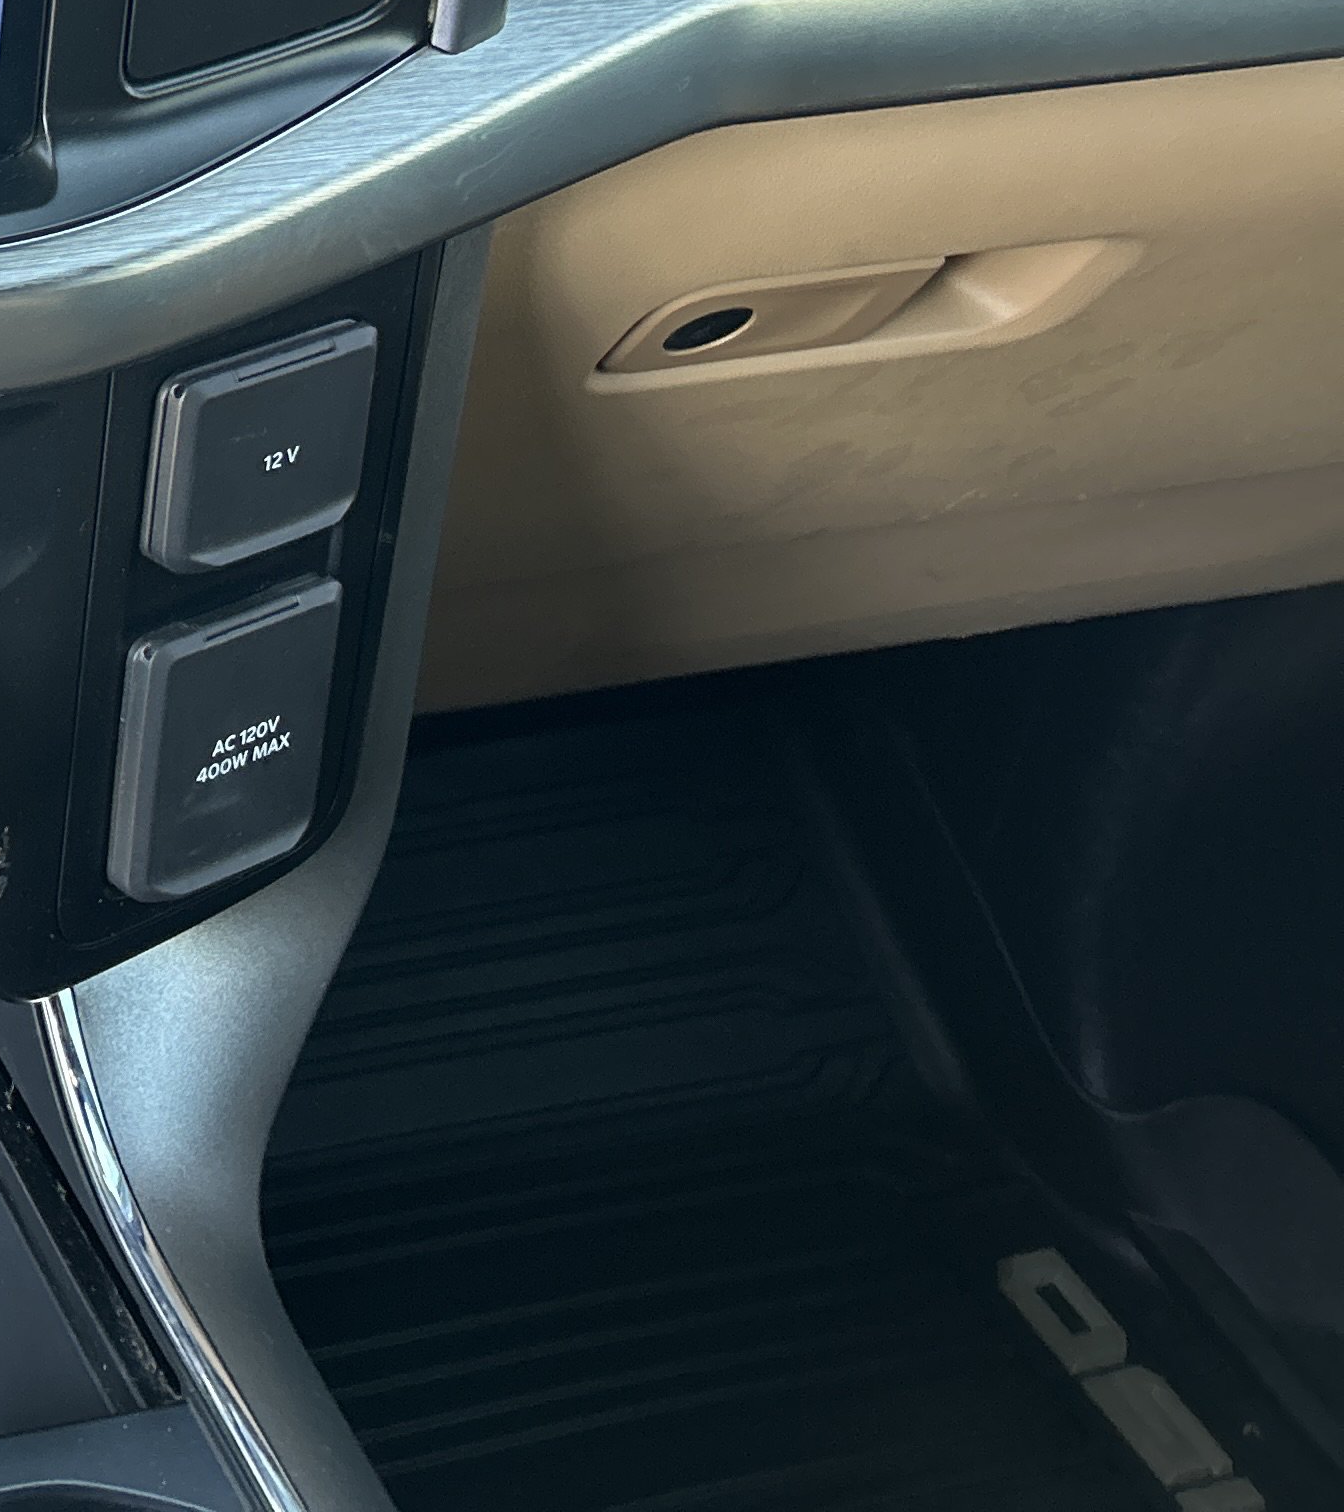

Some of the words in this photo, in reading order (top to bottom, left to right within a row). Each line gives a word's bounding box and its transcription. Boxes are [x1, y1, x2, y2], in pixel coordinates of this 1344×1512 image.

[262, 451, 284, 472] 12
[286, 445, 301, 465] V
[212, 732, 236, 757] AC
[239, 714, 281, 746] 120V
[196, 749, 250, 785] 400W
[252, 731, 292, 763] MAX
